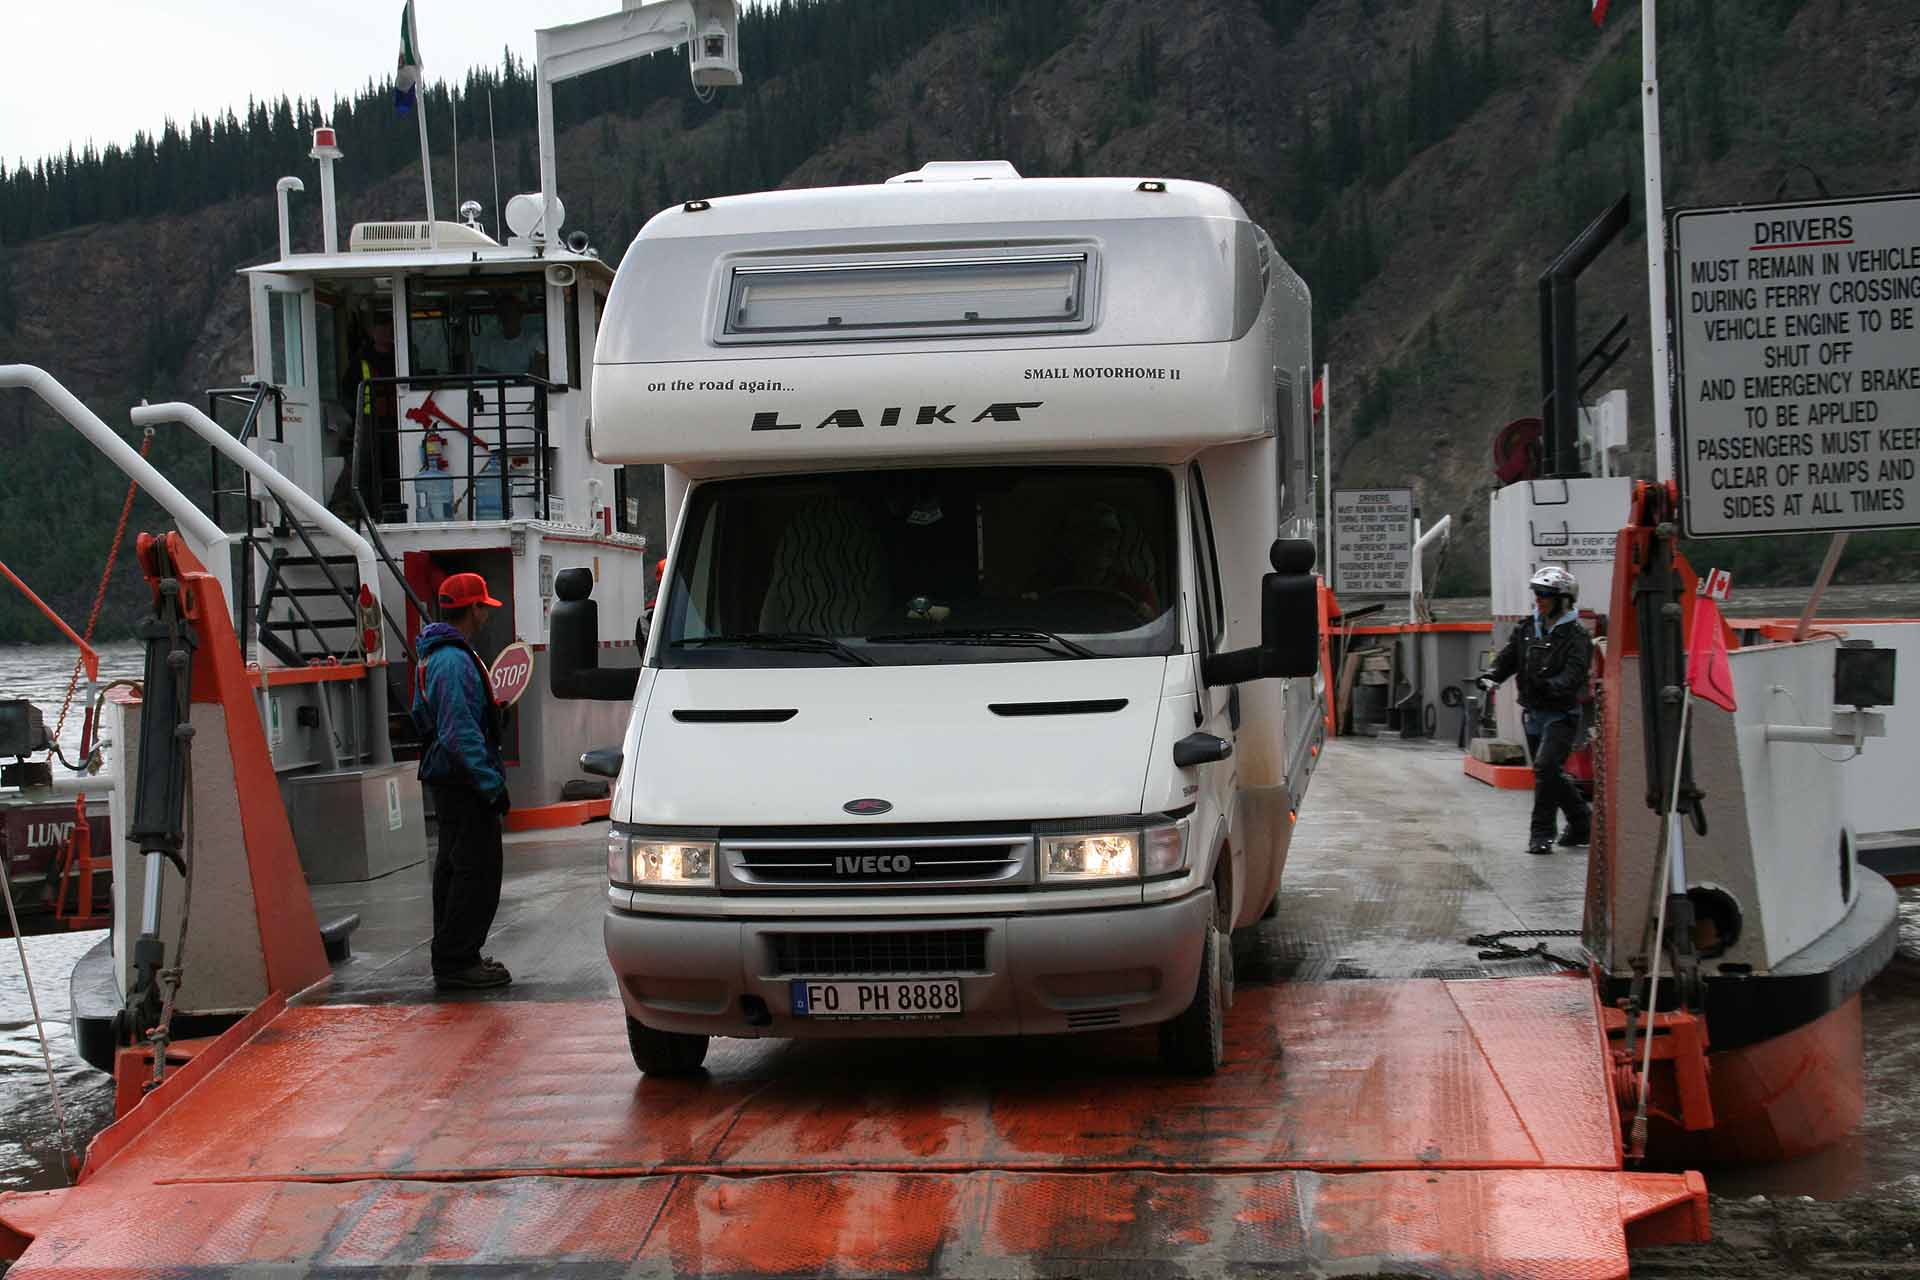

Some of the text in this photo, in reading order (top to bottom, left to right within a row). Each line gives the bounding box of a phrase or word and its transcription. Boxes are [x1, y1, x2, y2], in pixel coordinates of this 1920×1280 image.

[1755, 216, 1853, 244] DRIVERS
[1691, 246, 1920, 284] MUST REMAIN IN VEHICLE
[1691, 276, 1920, 313] DURING FERRY CROSSING
[1704, 307, 1914, 341] VEHICLE ENGINE TO BE
[1765, 341, 1854, 368] SHUT OFF
[647, 379, 795, 393] on the road again...
[1024, 368, 1070, 380] SMALL
[1073, 367, 1166, 379] MOTORHOME
[1699, 367, 1920, 402] AND EMERGENCY BRAKE
[751, 401, 1044, 431] LAIKA
[1744, 400, 1879, 429] TO BE APPLIED
[1698, 433, 1813, 462] PASSENGERS
[1821, 430, 1871, 454] MUST
[1711, 458, 1915, 490] CLEAR OF RAMPS AND
[1722, 487, 1905, 520] SIDES AT ALL TIMES
[494, 663, 527, 689] STOP
[835, 854, 912, 874] IVECO
[857, 985, 889, 1011] PH
[898, 983, 959, 1010] 8888
